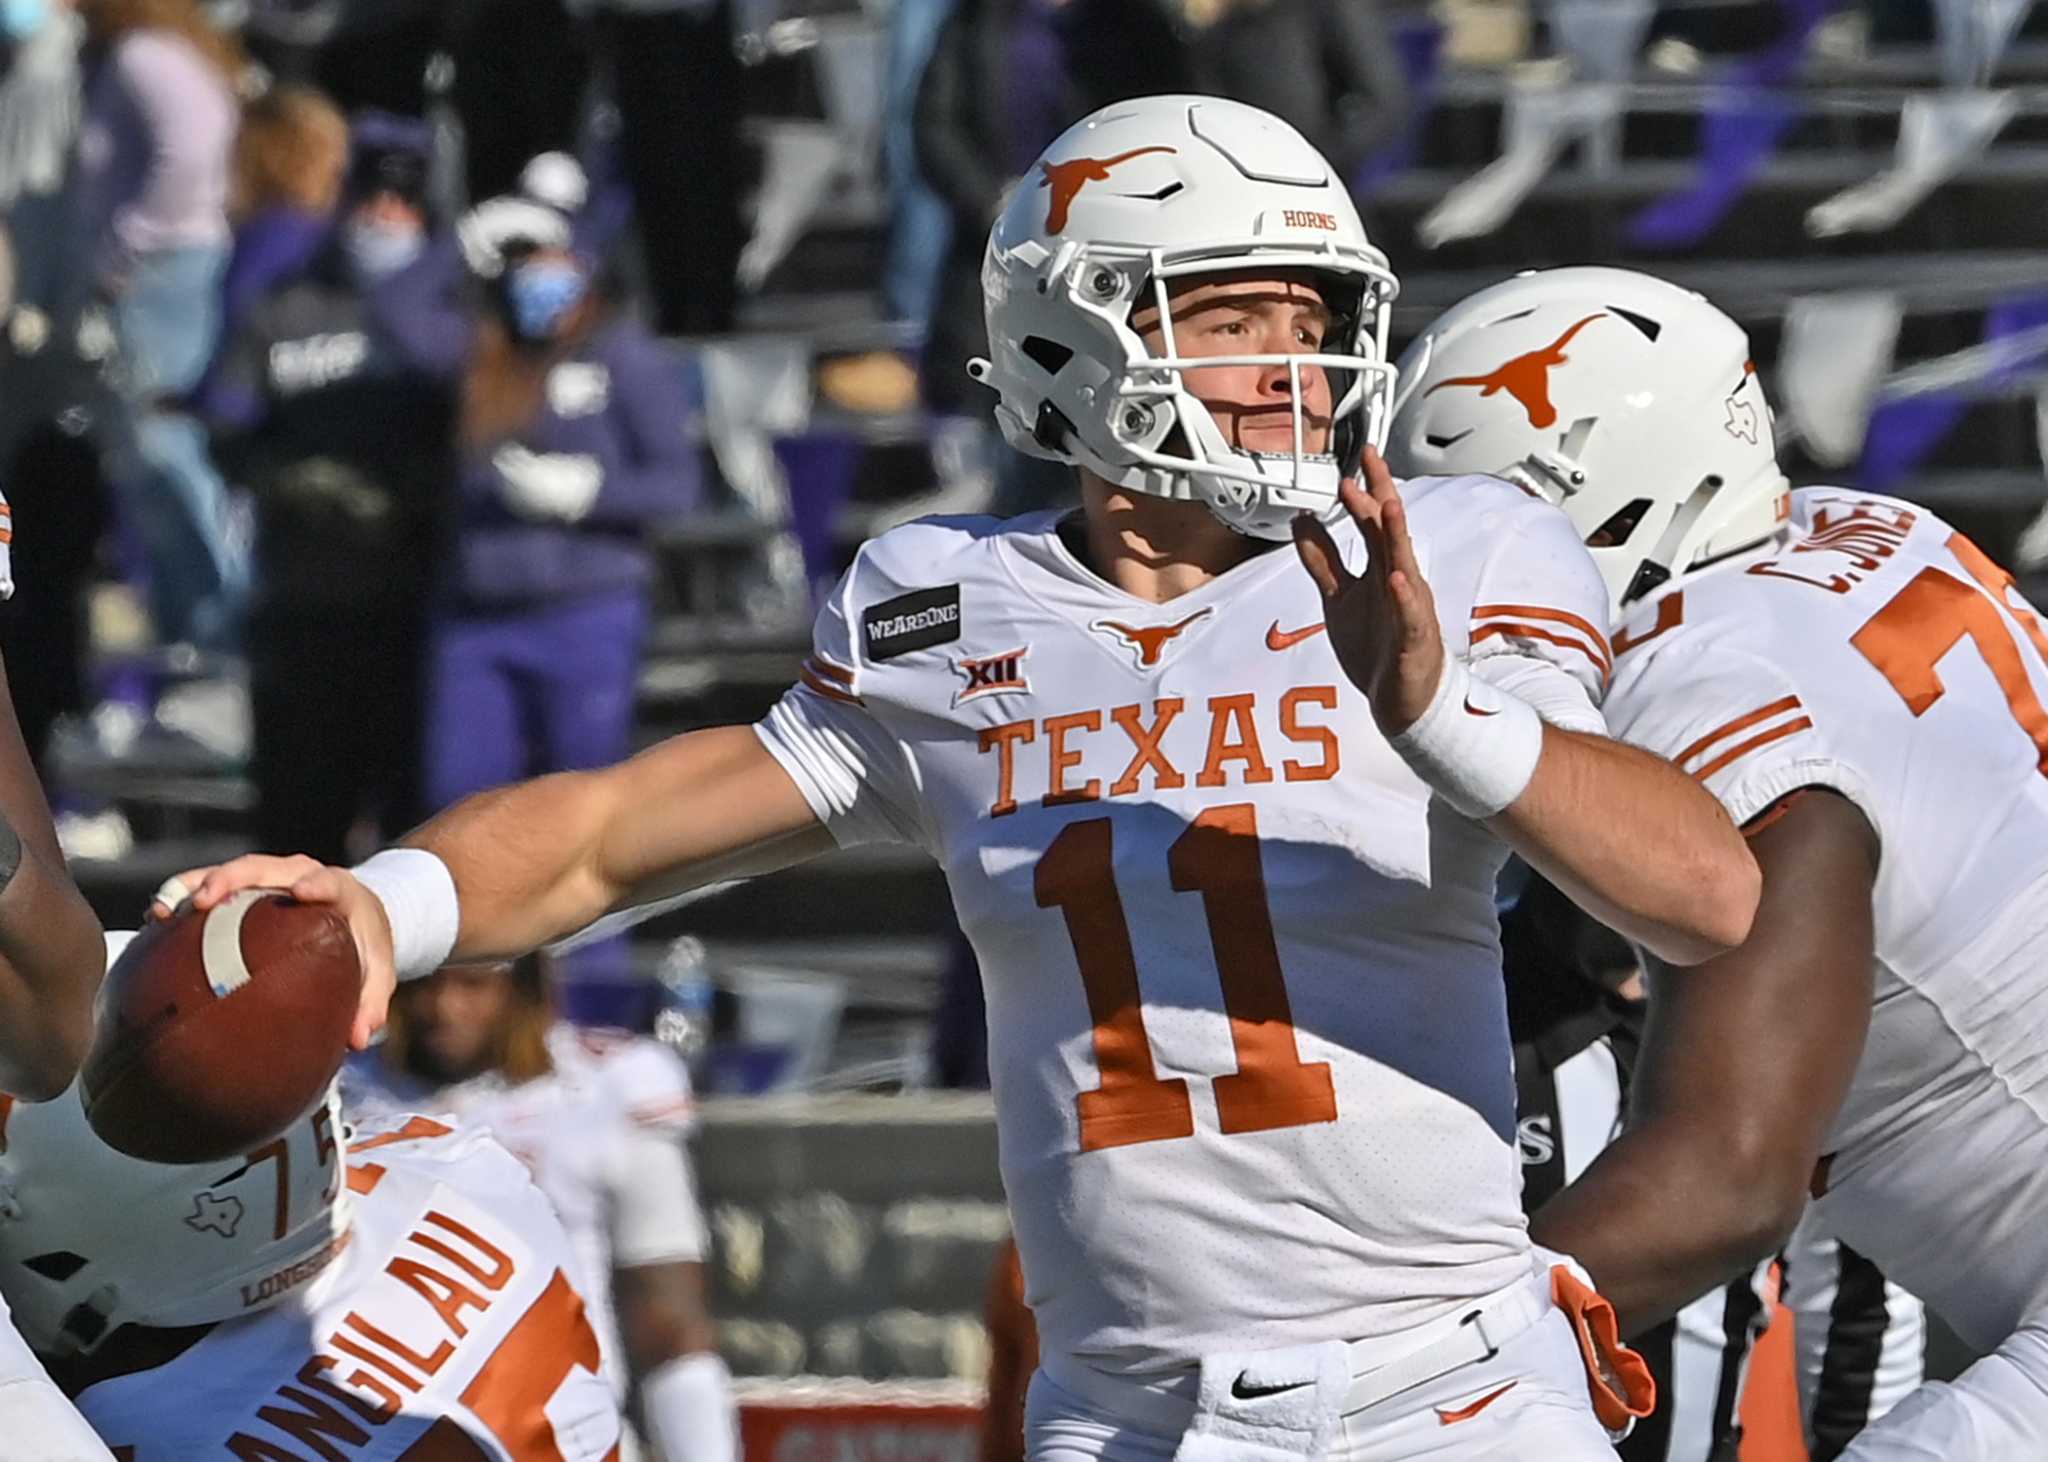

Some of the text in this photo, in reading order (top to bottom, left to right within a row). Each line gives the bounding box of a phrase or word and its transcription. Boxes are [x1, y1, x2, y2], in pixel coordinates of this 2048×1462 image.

[1282, 209, 1337, 231] HORNS
[977, 682, 1341, 820] TEXAS
[1033, 802, 1338, 1153] 11
[246, 1104, 339, 1241] 75
